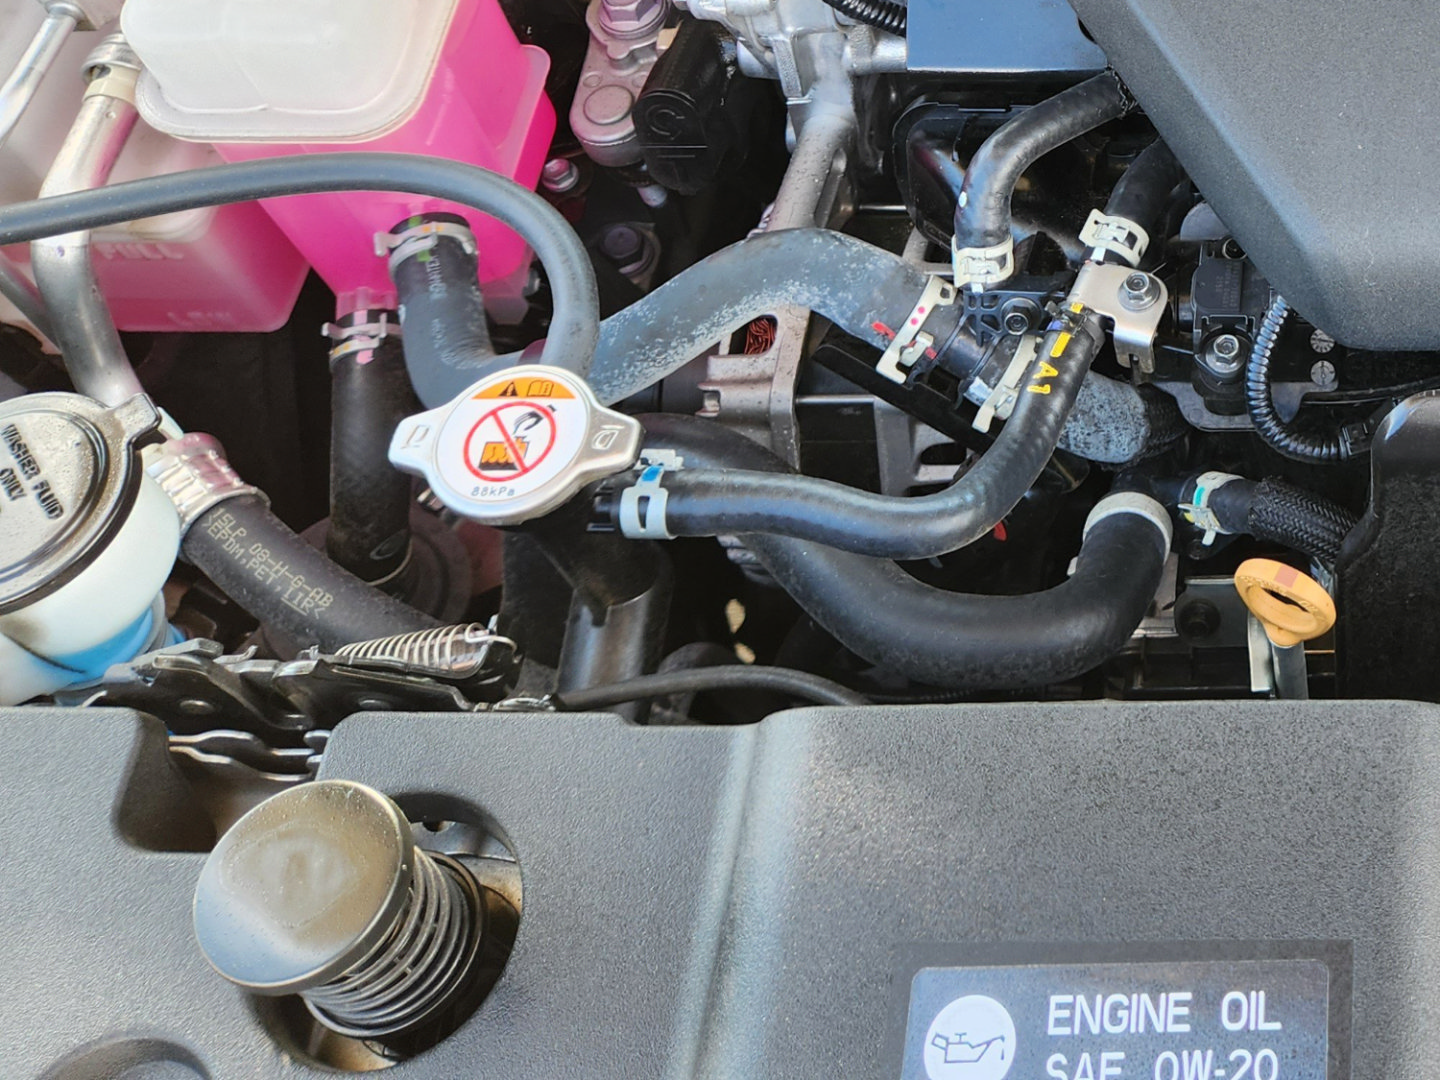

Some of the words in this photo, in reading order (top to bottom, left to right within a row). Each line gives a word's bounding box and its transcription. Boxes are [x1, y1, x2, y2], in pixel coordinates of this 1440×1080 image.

[0, 467, 28, 502] ONLY
[1, 423, 41, 481] WASHER
[31, 479, 65, 520] FLUID
[471, 485, 516, 497] 88kPa
[1047, 991, 1193, 1036] ENGINE
[1220, 989, 1283, 1032] OIL
[1154, 1047, 1279, 1080] 0W-20
